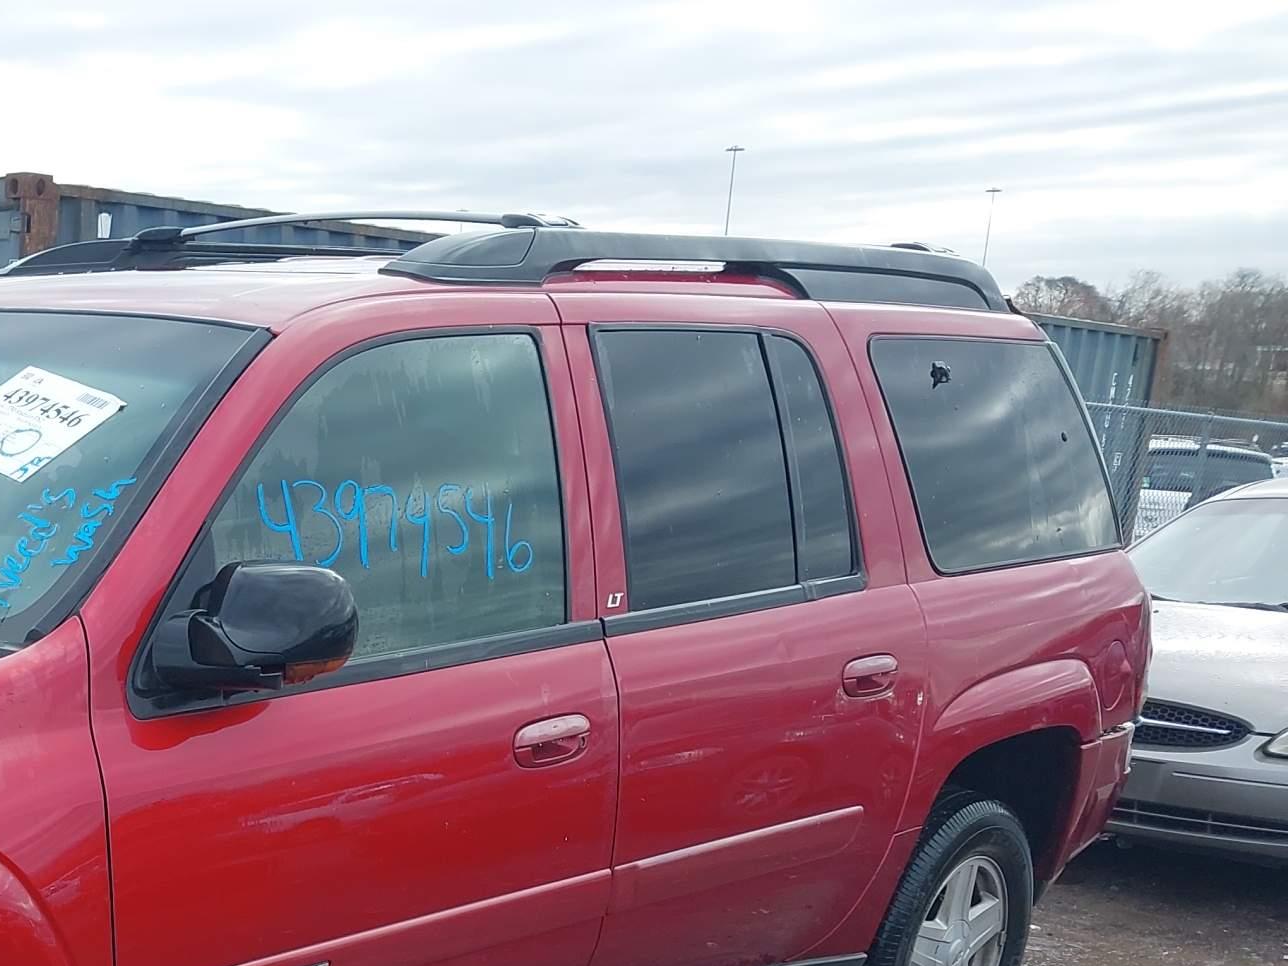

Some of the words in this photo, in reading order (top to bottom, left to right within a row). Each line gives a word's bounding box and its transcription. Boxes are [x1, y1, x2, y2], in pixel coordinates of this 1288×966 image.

[2, 387, 90, 428] 43974546
[256, 478, 534, 580] 43974546
[606, 592, 625, 608] LT
